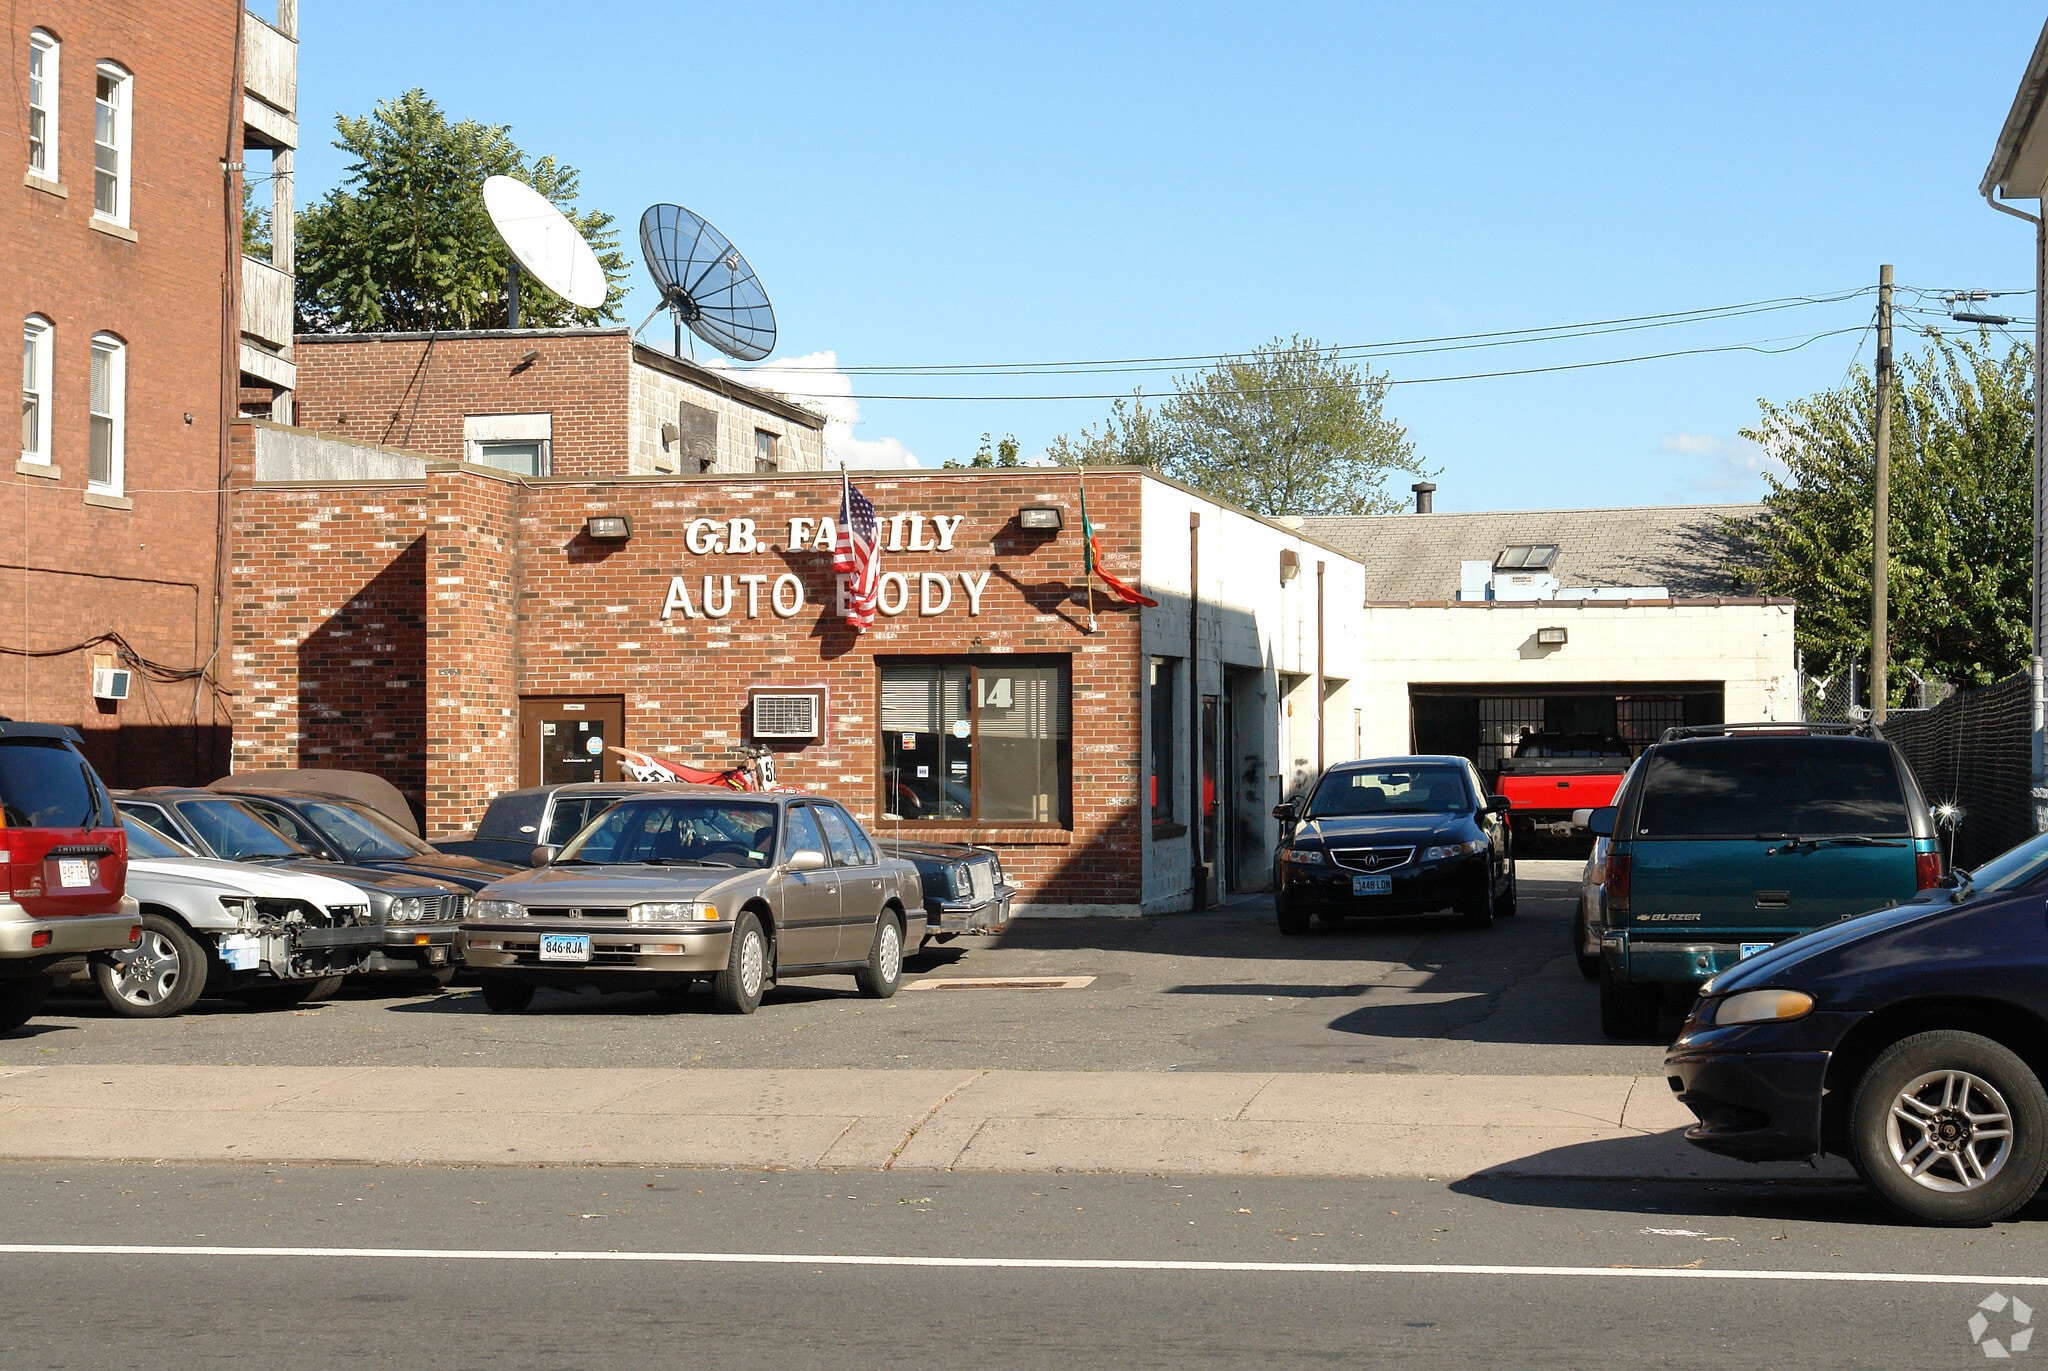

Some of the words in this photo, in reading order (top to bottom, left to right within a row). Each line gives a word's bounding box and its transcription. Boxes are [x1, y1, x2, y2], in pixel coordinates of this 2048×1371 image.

[686, 517, 767, 555] G.B.
[786, 514, 966, 553] FAILY
[660, 572, 806, 620] AUTO
[62, 845, 107, 853] MITSUBISHI
[1650, 913, 1702, 921] BLAZER
